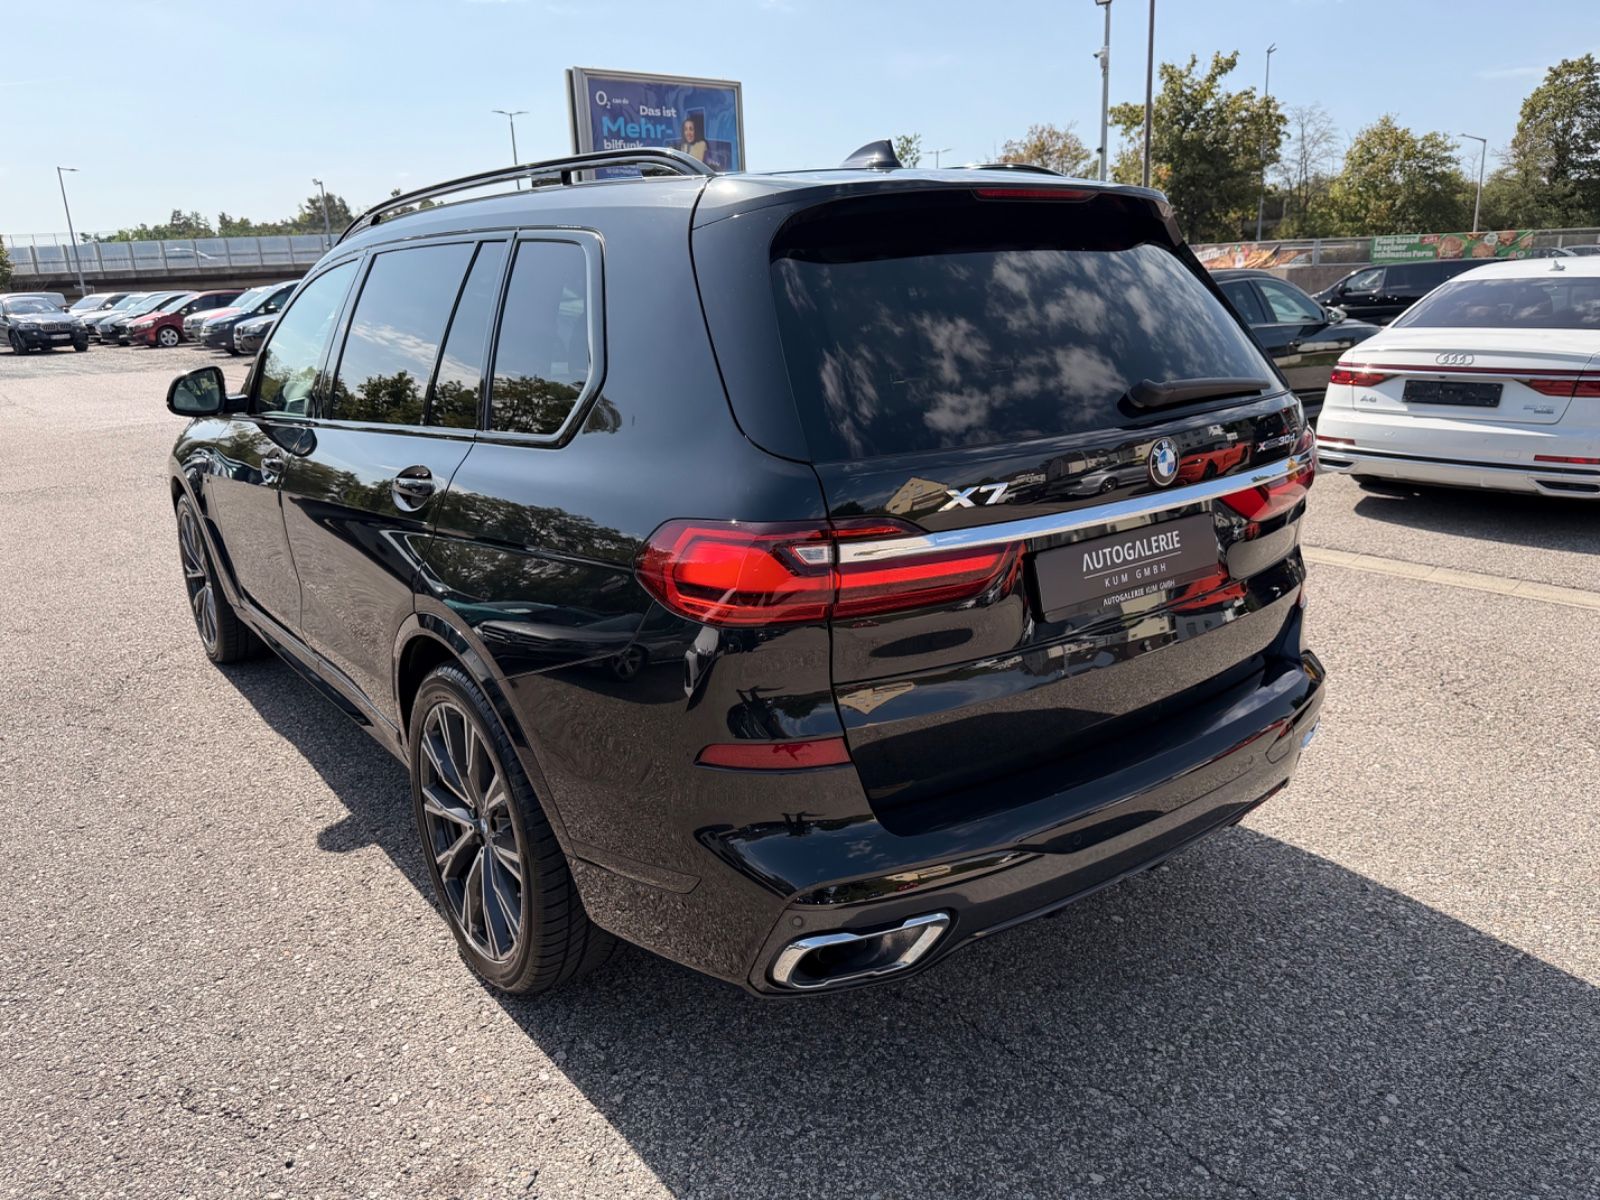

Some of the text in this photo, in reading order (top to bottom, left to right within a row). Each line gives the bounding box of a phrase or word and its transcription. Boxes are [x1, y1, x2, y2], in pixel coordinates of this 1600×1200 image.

[595, 90, 611, 109] O2
[640, 105, 677, 118] Das ist
[602, 115, 673, 139] Mehr-
[938, 482, 1009, 512] X7
[1083, 531, 1181, 572] AUTOGALERIE
[1104, 563, 1167, 588] KUM GMBH
[1103, 579, 1176, 607] AUTOGALERIE KUM GMBH
